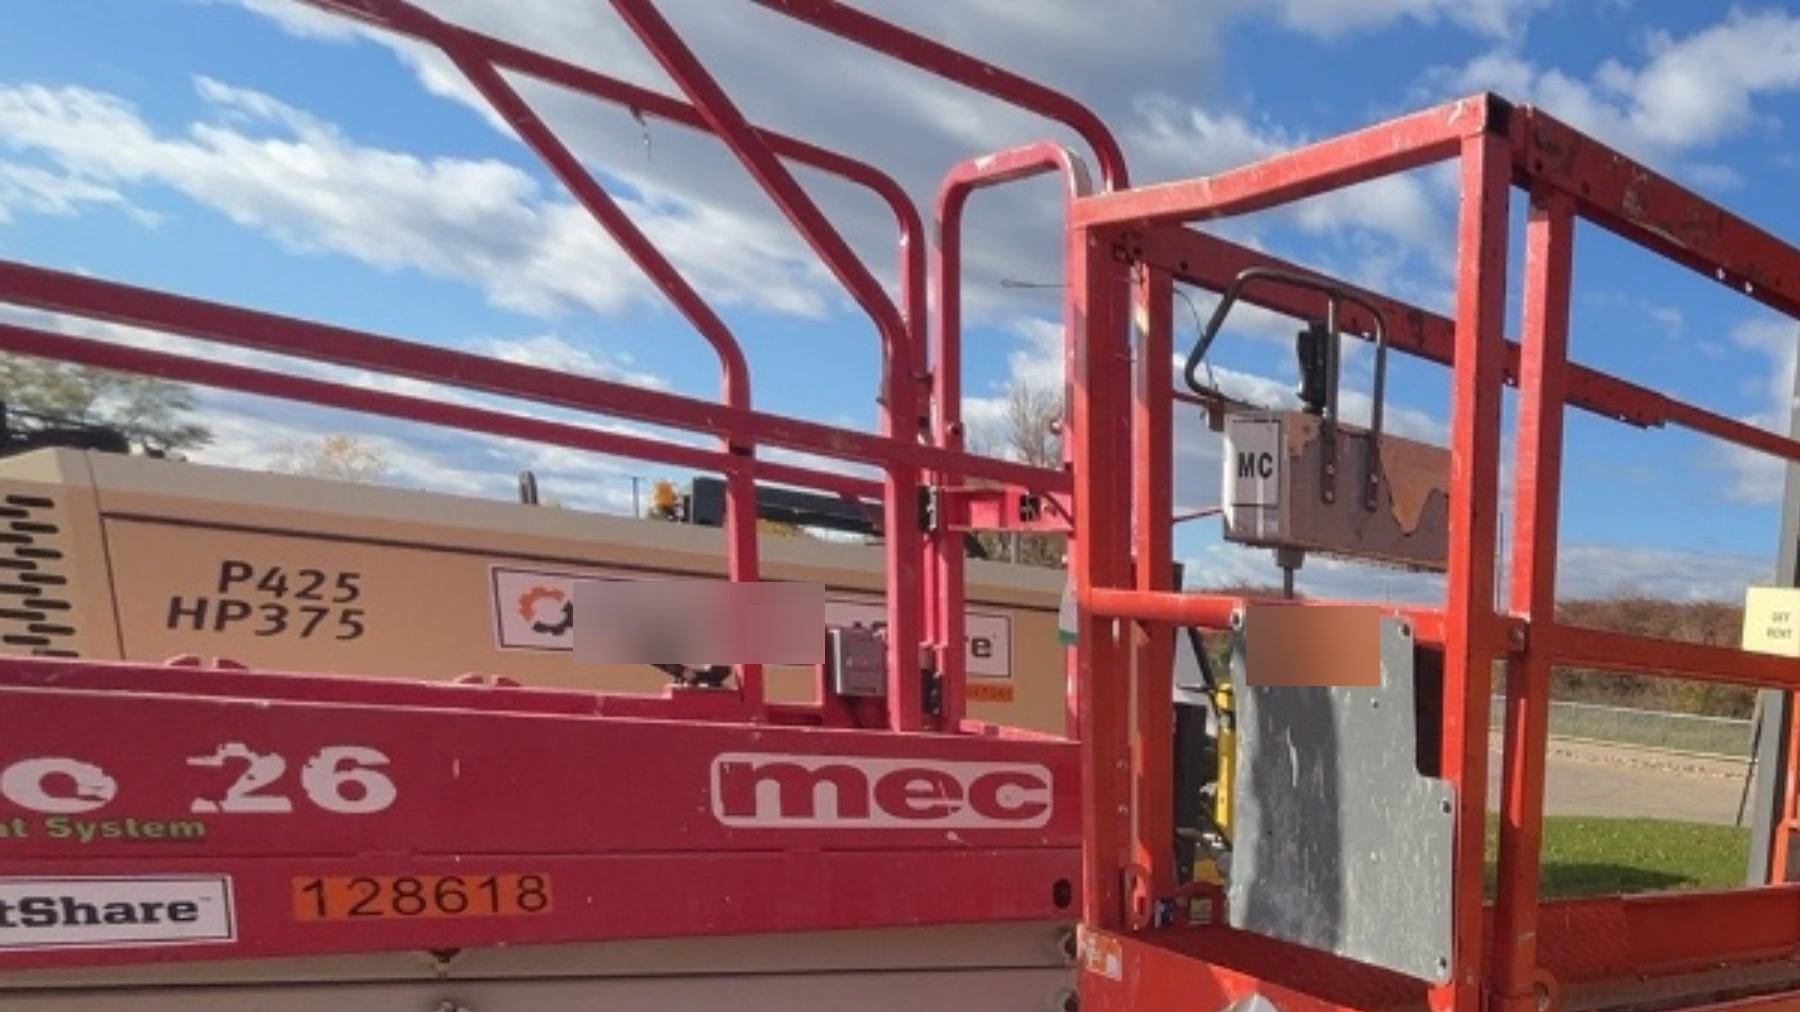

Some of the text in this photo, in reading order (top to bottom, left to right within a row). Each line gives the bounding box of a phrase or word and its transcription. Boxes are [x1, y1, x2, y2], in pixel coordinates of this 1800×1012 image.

[1238, 451, 1273, 479] MC
[218, 560, 362, 602] P425
[166, 596, 365, 641] HP375
[186, 743, 397, 814] 26
[718, 760, 1049, 822] mec
[45, 815, 205, 844] System
[302, 874, 548, 917] 128618
